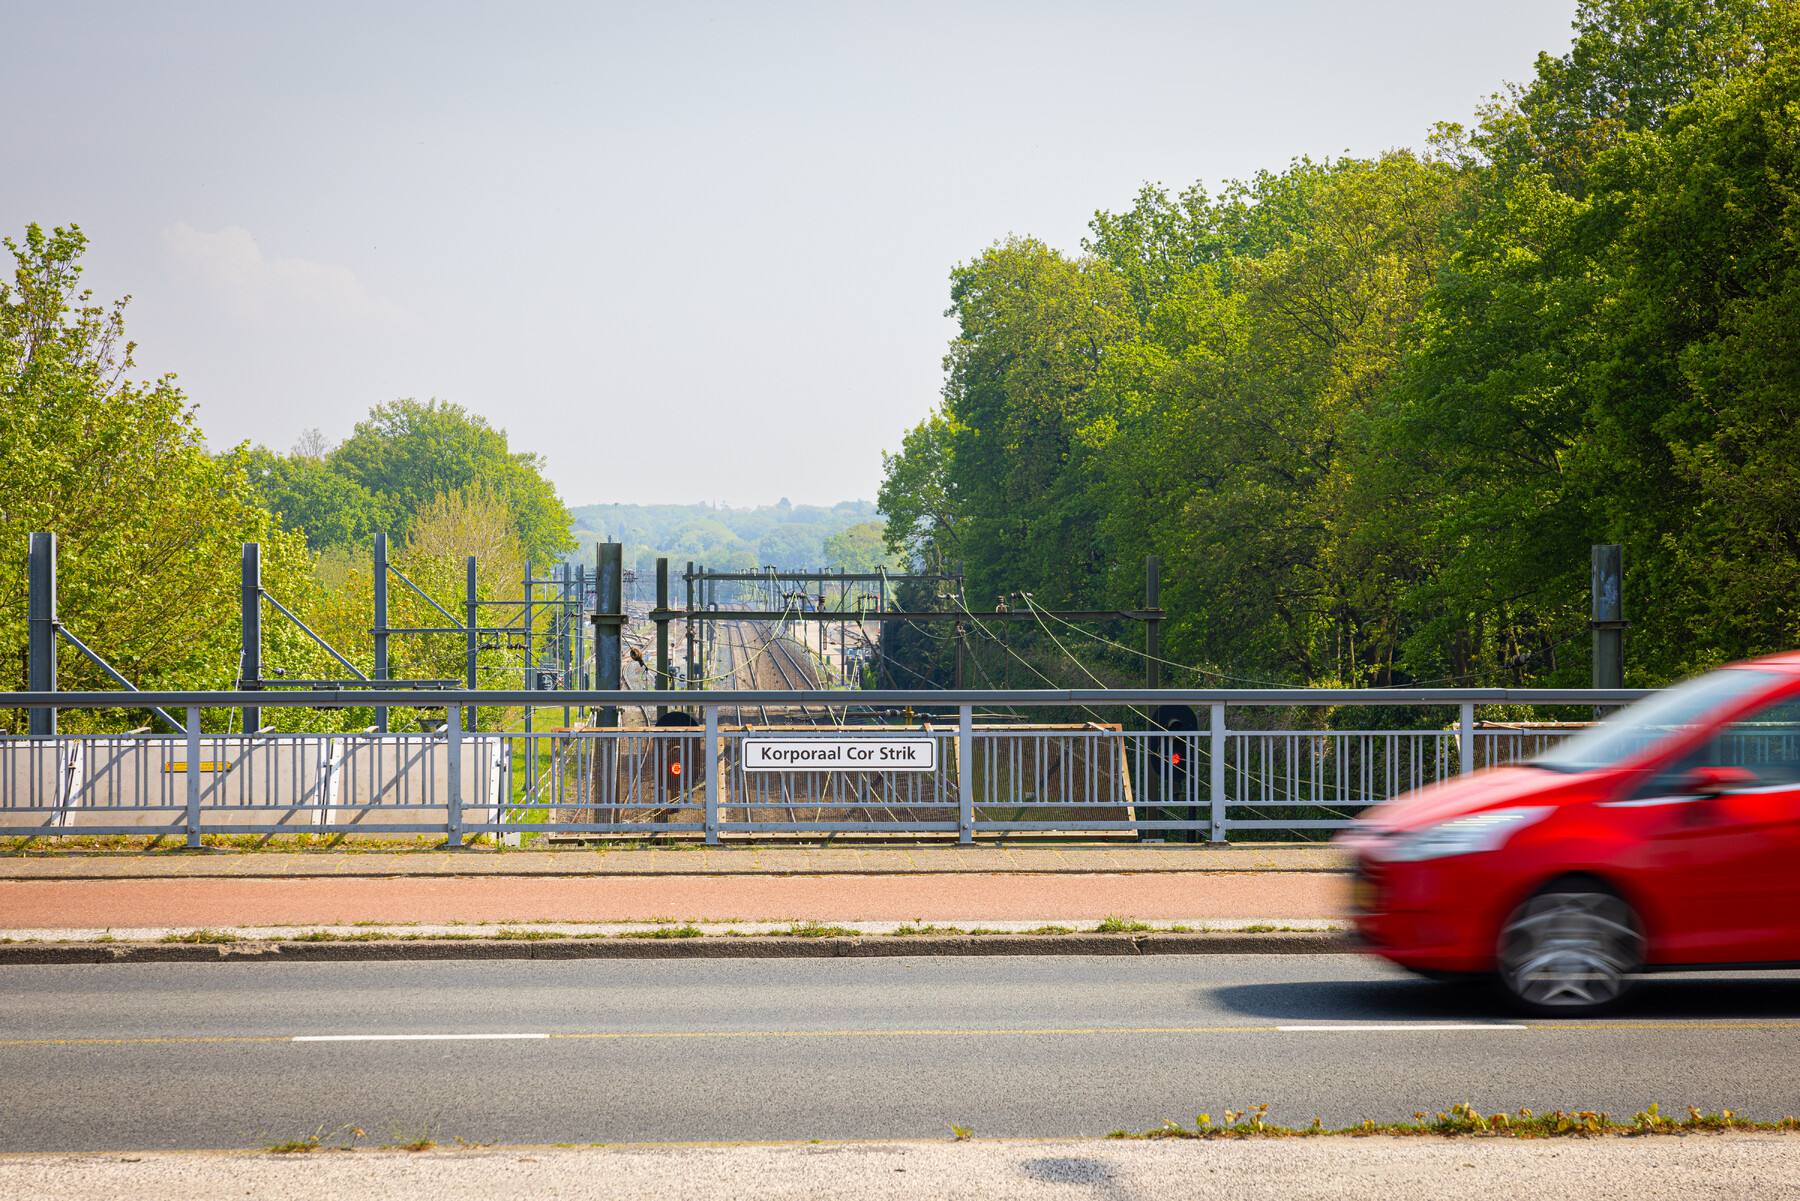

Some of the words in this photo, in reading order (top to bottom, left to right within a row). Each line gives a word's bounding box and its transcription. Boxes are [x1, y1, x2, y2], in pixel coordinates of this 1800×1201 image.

[761, 746, 841, 763] Korporaal
[847, 746, 874, 760] Cor
[880, 746, 916, 760] Strik
